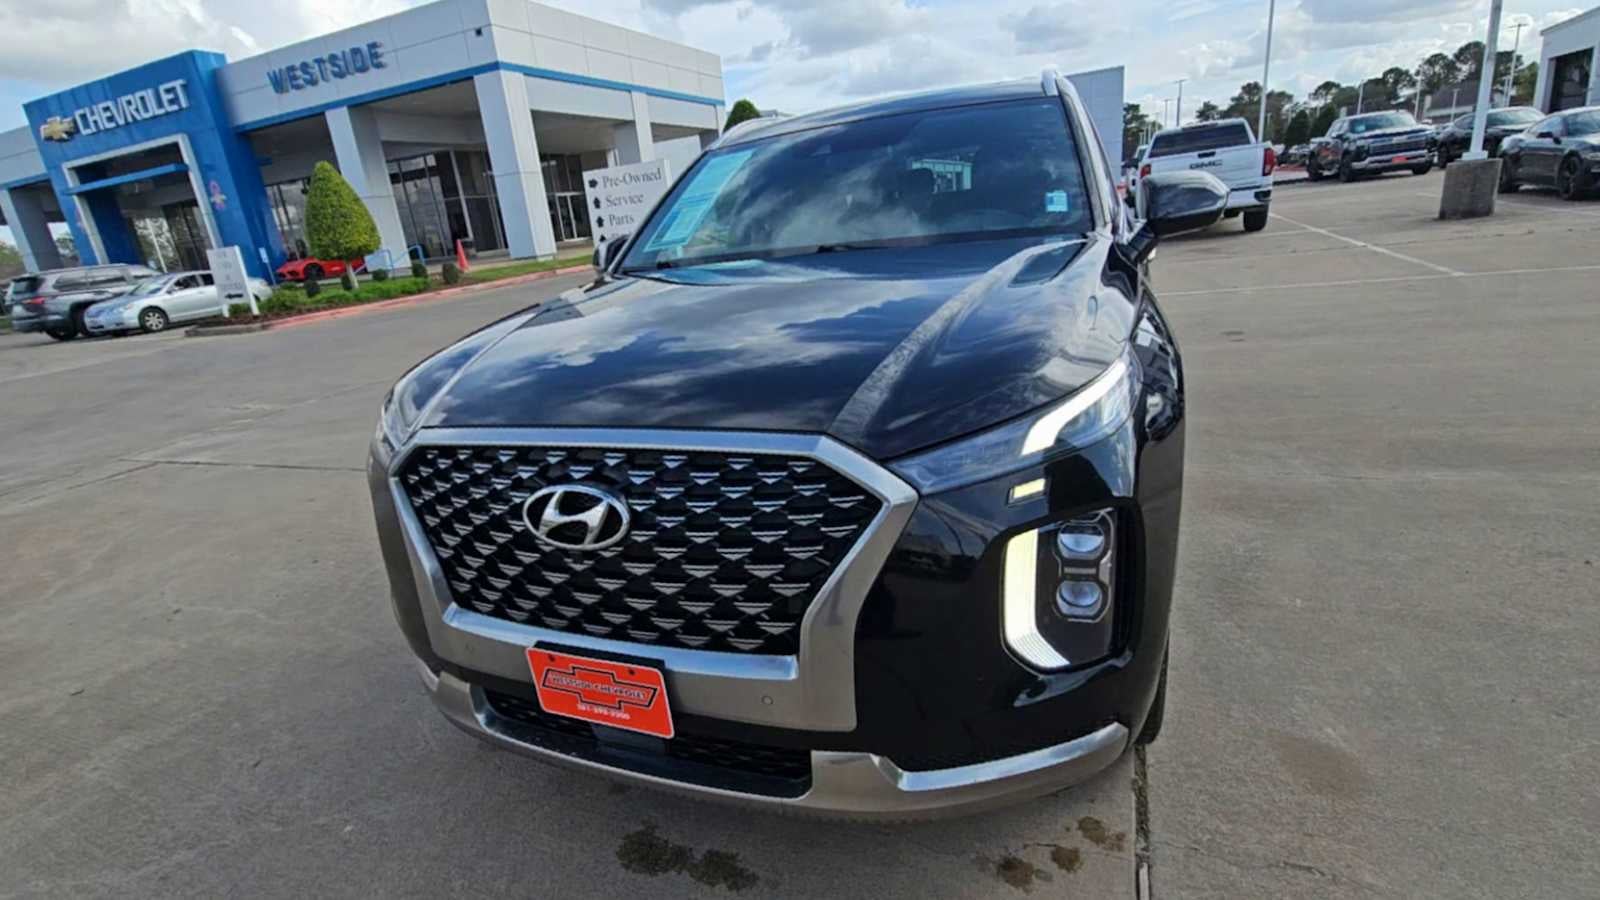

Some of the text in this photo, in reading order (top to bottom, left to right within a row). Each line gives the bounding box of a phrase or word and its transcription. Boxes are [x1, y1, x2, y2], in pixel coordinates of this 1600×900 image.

[267, 41, 386, 94] WESTSIDE
[74, 79, 189, 136] CHEVROLET
[1189, 160, 1223, 169] GMC
[601, 168, 661, 189] Pre-Owned
[605, 193, 645, 208] Service
[608, 214, 635, 227] Parts
